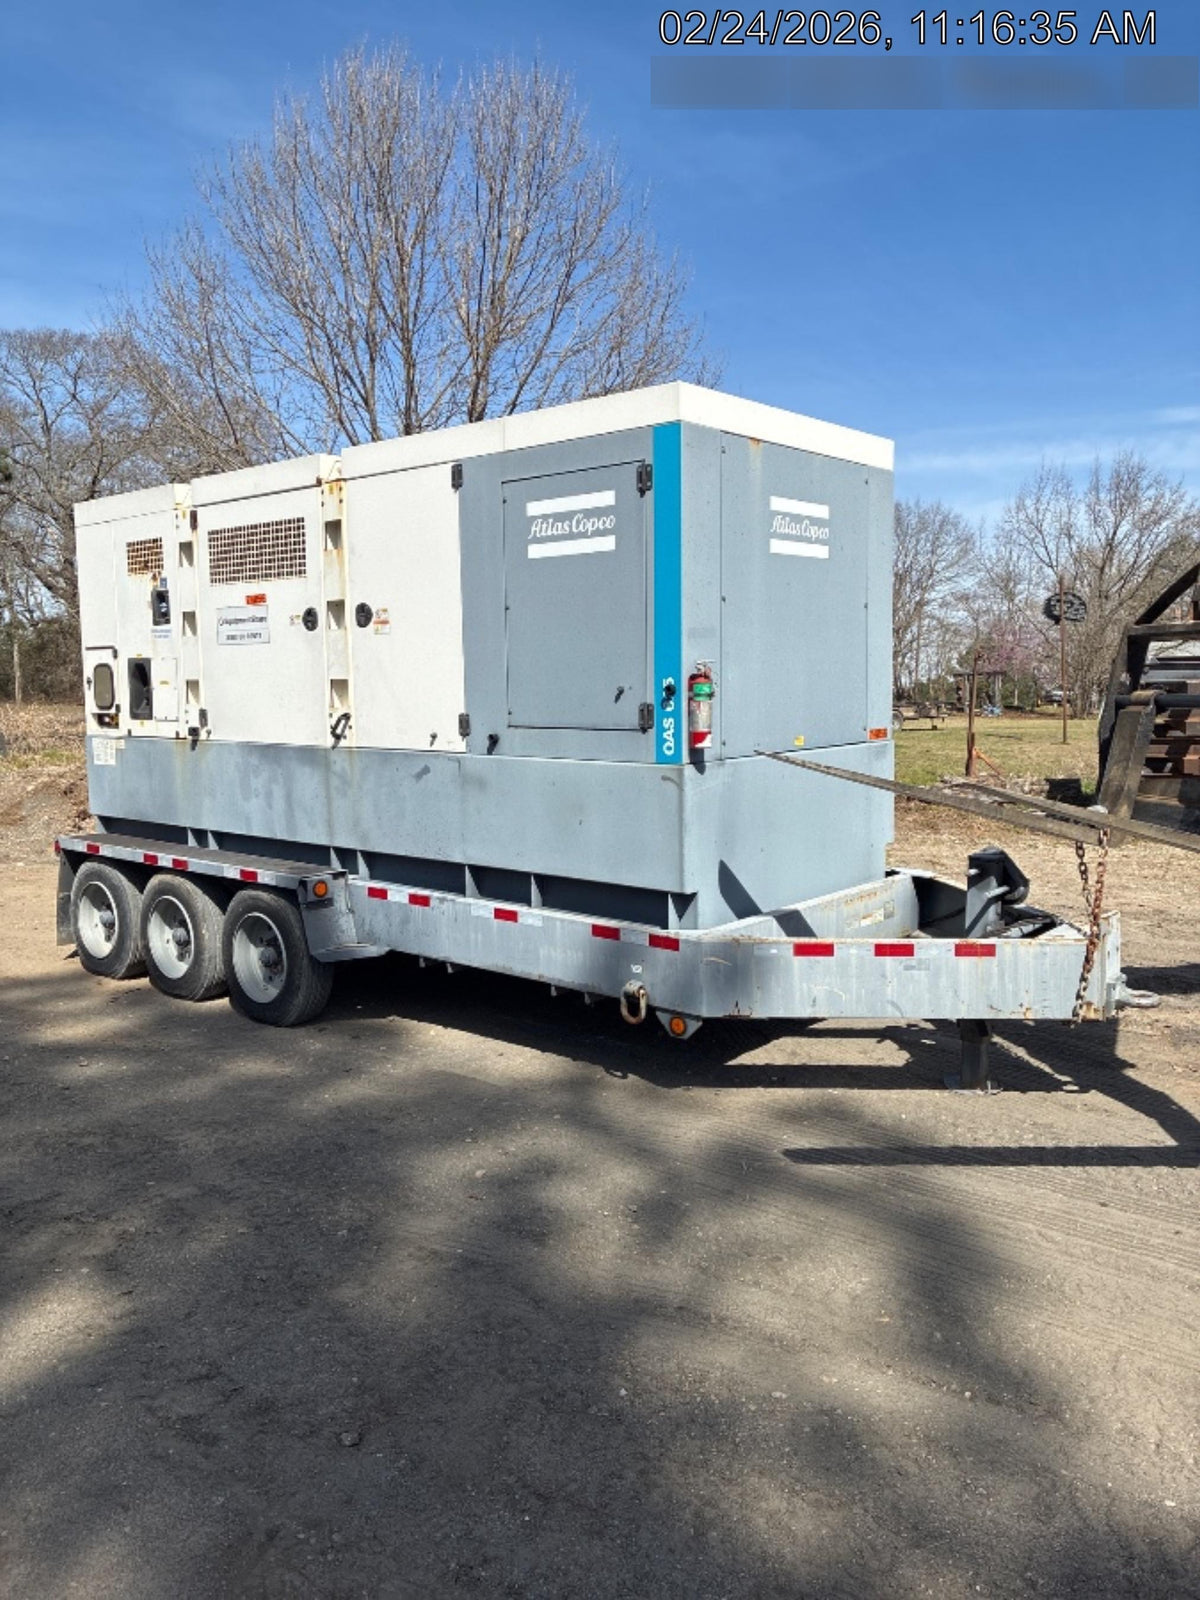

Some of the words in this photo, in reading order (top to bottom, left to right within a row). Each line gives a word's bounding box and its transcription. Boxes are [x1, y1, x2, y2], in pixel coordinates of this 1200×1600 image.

[528, 518, 571, 539] Atlas
[572, 513, 615, 536] Copco
[770, 515, 800, 535] Atlas
[663, 718, 675, 755] QAS
